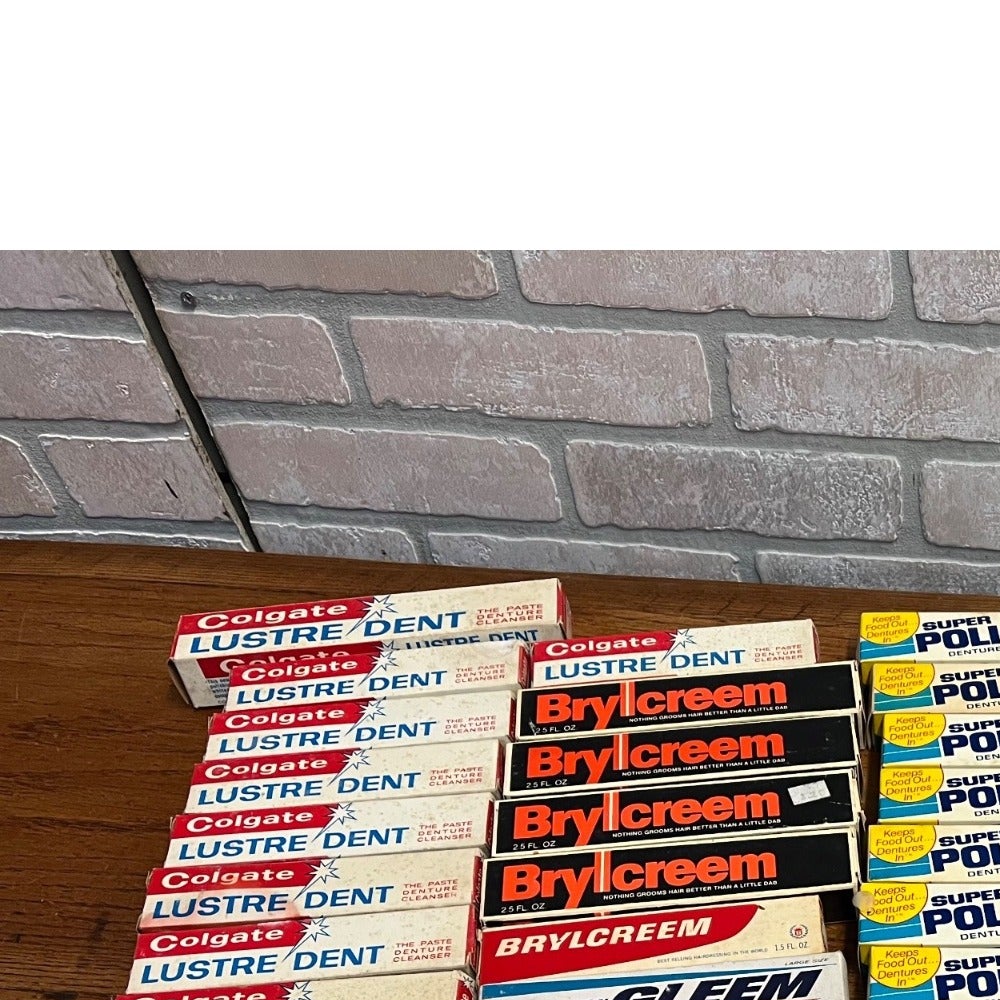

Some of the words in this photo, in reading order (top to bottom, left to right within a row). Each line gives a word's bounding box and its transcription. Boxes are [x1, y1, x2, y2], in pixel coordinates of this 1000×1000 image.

[189, 623, 343, 654] LUSTRE
[363, 611, 467, 637] DENT
[197, 602, 348, 631] Colgate
[922, 616, 991, 631] SUPER
[545, 635, 657, 656] Colgate
[241, 658, 358, 682] Colgate
[544, 656, 656, 680] LUSTRE
[670, 649, 746, 669] DENT
[236, 680, 354, 705] LUSTRE
[368, 670, 448, 691] DENT
[225, 706, 345, 729] Colgate
[536, 680, 787, 730] Brylcreem
[218, 729, 341, 754] LUSTRE
[355, 721, 437, 742] DENT
[204, 757, 329, 780] Colgate
[526, 732, 784, 784] Brylcreem
[197, 779, 322, 806] LUSTRE
[336, 772, 422, 794] DENT
[186, 810, 314, 832] Colgate
[513, 791, 780, 846] Brylcreem
[179, 831, 308, 860] LUSTRE
[322, 826, 410, 849] DENT
[161, 868, 295, 889] Colgate
[502, 850, 777, 910] Brylcreem
[152, 892, 288, 919] LUSTRE
[304, 885, 394, 909] DENT
[149, 928, 285, 952] Colgate
[494, 916, 713, 958] BRYLCREEM
[140, 954, 278, 984] LUSTRE
[292, 945, 385, 971] DENT
